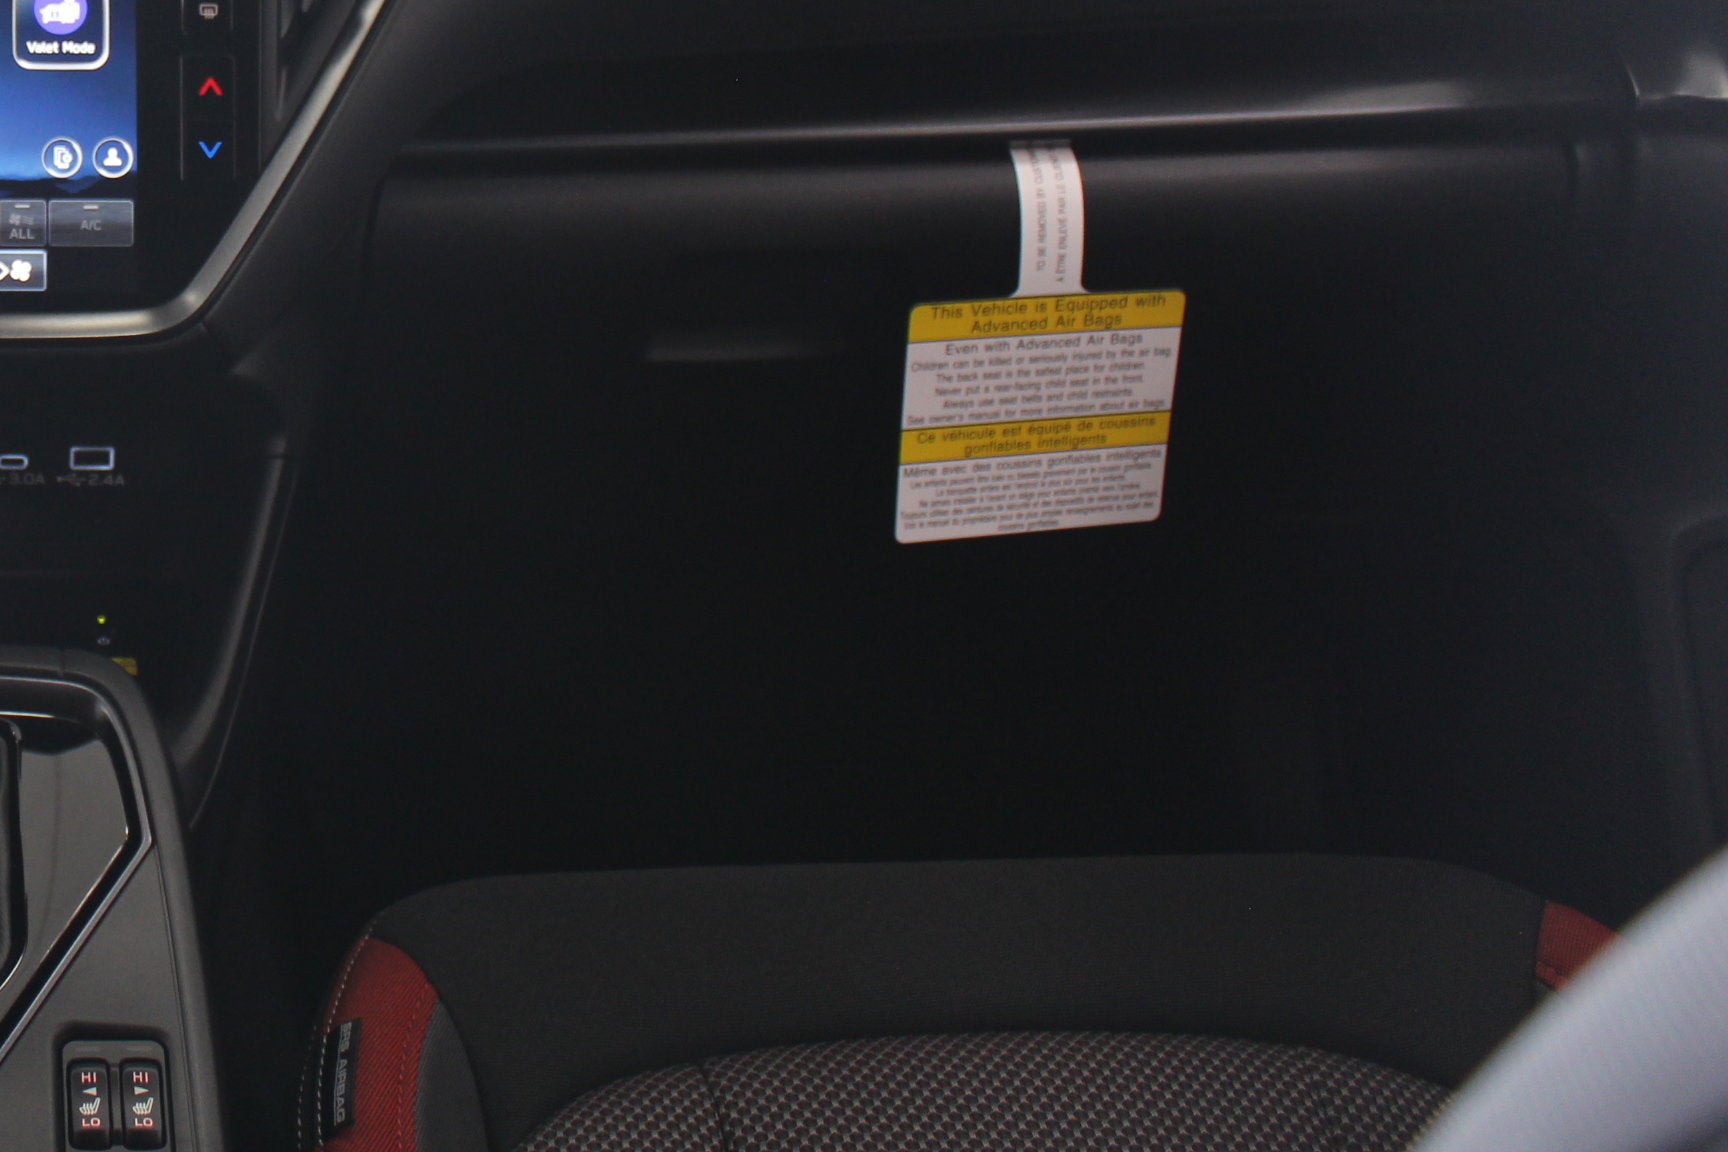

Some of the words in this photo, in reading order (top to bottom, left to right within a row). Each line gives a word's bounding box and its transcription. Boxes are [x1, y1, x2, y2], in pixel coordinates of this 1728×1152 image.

[27, 40, 59, 54] Valet
[62, 41, 95, 54] Mode
[80, 218, 102, 231] A/C
[1037, 203, 1047, 243] REMOVED
[8, 228, 35, 240] ALL
[931, 306, 963, 319] This
[971, 302, 1028, 316] Vehicle
[1036, 302, 1047, 312] is
[1055, 296, 1128, 313] Equipped
[1136, 294, 1166, 306] with
[971, 317, 1048, 333] Advanced
[1056, 316, 1075, 327] Air
[1084, 314, 1122, 329] Bags
[945, 344, 978, 355] Even
[984, 341, 1010, 352] with
[1016, 336, 1081, 350] Advanced
[1087, 335, 1104, 345] Air
[1110, 333, 1143, 346] Bags
[912, 361, 950, 372] Children
[973, 359, 984, 367] be
[988, 358, 1012, 366] killed
[1029, 354, 1067, 364] seriously
[1072, 352, 1102, 361] injured
[1105, 350, 1115, 359] by
[1138, 348, 1150, 356] air
[936, 373, 953, 382] The
[957, 372, 977, 381] back
[983, 371, 1002, 379] seat
[1017, 369, 1030, 377] the
[1065, 366, 1089, 376] place
[1093, 364, 1105, 372] for
[935, 387, 962, 395] Never
[965, 386, 980, 395] put
[1045, 380, 1066, 388] child
[1070, 378, 1089, 386] seat
[1093, 377, 1101, 385] in
[1104, 376, 1118, 385] the
[943, 400, 974, 409] Always
[998, 397, 1018, 405] seat
[1047, 392, 1064, 401] and
[1067, 391, 1088, 400] child
[907, 416, 925, 424] See
[968, 411, 1000, 420] manual
[1004, 409, 1016, 417] for
[1020, 408, 1043, 417] more
[1047, 404, 1095, 414] information
[1100, 401, 1125, 410] about
[1128, 400, 1140, 408] air
[917, 432, 935, 444] Ce
[942, 428, 996, 441] véhicule
[1002, 427, 1022, 437] est
[1078, 421, 1093, 431] de
[1099, 417, 1156, 430] coussins
[1037, 434, 1107, 449] intelligents
[942, 466, 966, 474] avec
[973, 463, 991, 472] des
[996, 459, 1042, 470] coussins
[88, 473, 125, 486] 2.4A
[340, 1021, 353, 1052] SRS
[81, 1072, 96, 1083] HI
[133, 1072, 149, 1083] HI
[336, 1058, 348, 1124] AIRBAG
[82, 1118, 101, 1128] LO
[135, 1118, 153, 1128] LO
